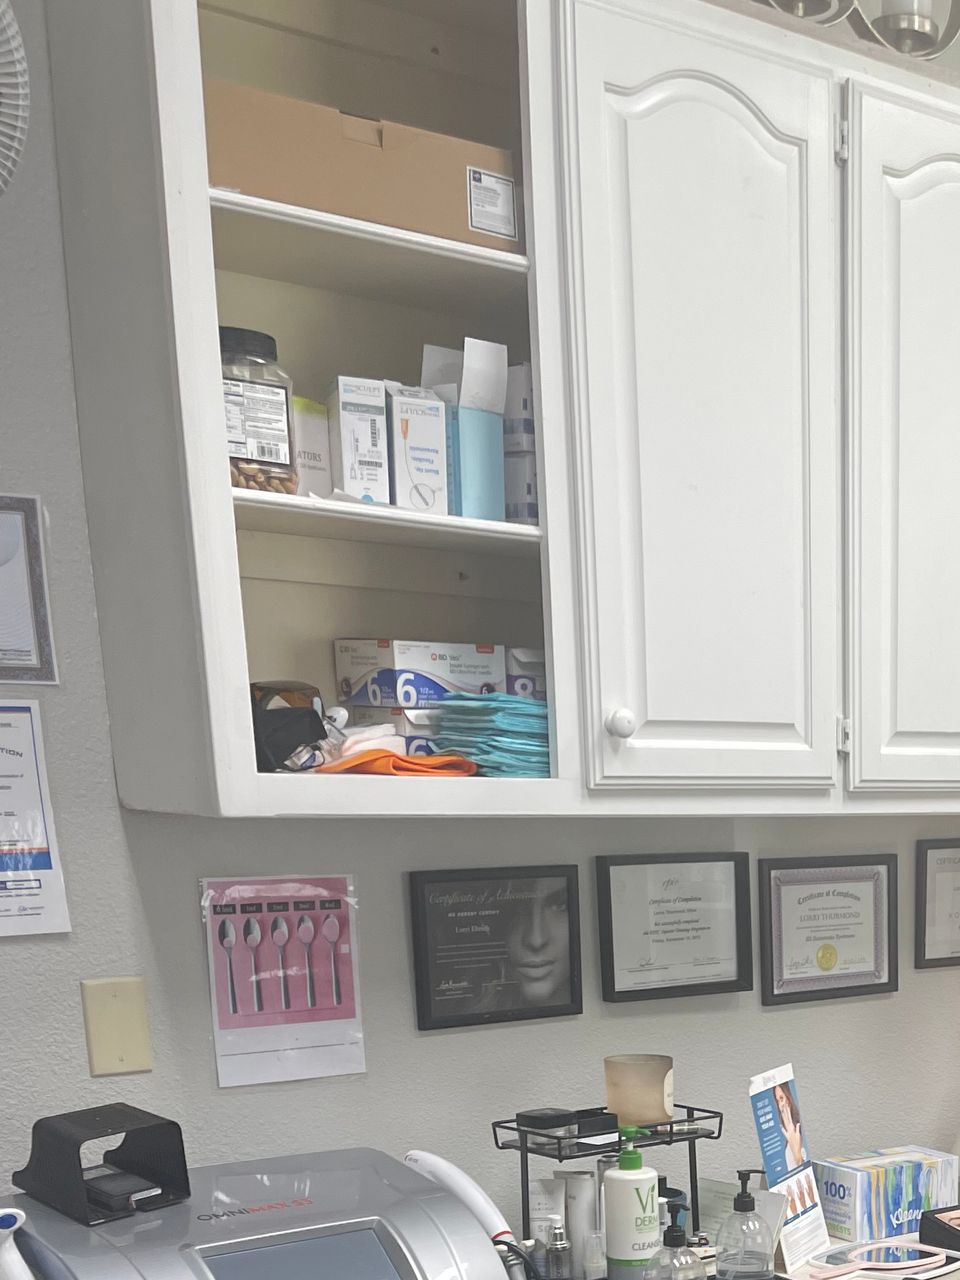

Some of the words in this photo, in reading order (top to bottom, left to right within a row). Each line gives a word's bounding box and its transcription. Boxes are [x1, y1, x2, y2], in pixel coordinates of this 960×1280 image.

[367, 675, 382, 705] 6
[397, 672, 417, 708] 6
[824, 1180, 852, 1200] 100%
[890, 1208, 924, 1228] Kleen
